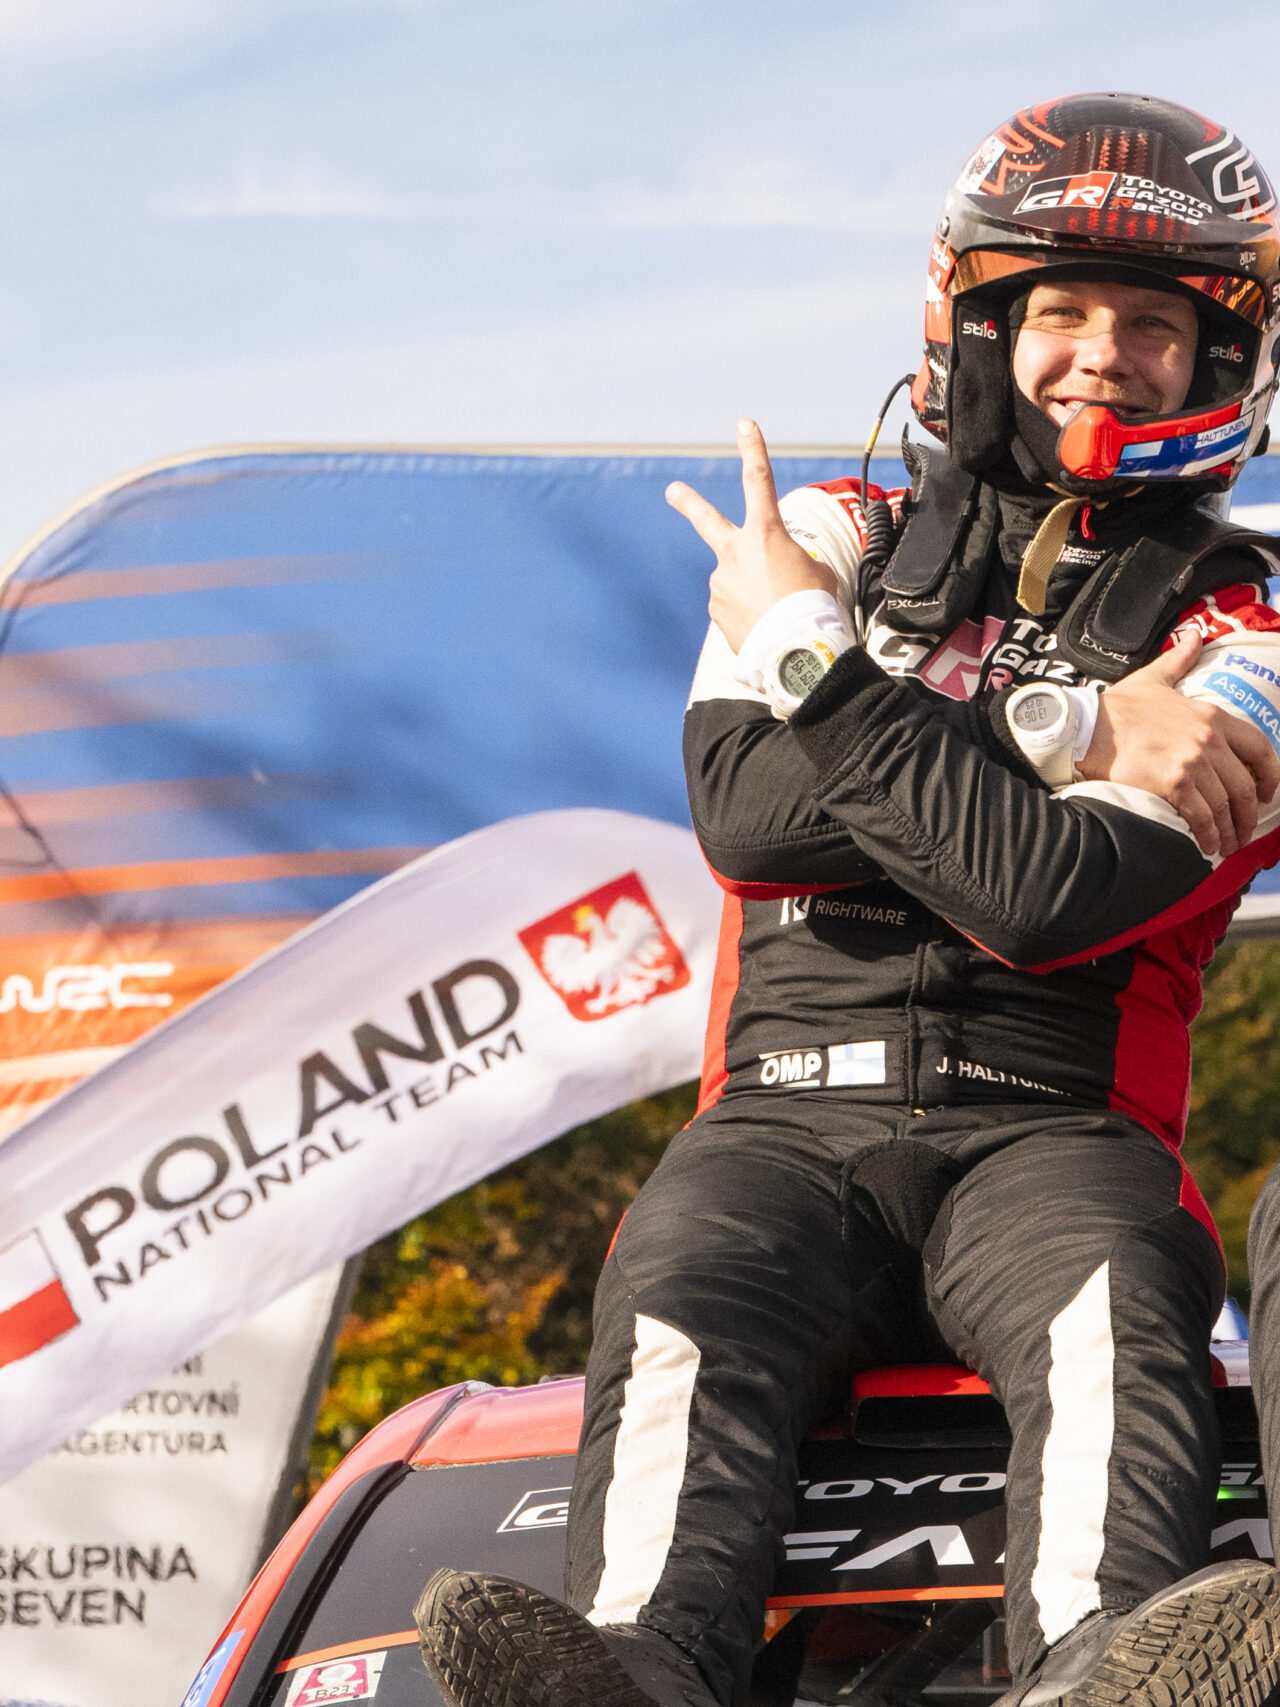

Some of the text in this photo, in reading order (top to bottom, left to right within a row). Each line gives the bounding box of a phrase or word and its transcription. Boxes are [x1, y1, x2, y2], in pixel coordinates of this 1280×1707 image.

[1020, 186, 1104, 211] GR
[1116, 186, 1204, 219] GAZOO
[1122, 174, 1213, 214] TOYOTA
[815, 900, 908, 926] RIGHTWARE
[760, 1052, 823, 1086] OMP
[936, 1056, 952, 1075] J.
[64, 958, 521, 1268] POLAND
[92, 1030, 525, 1303] NATIONAL TEAM
